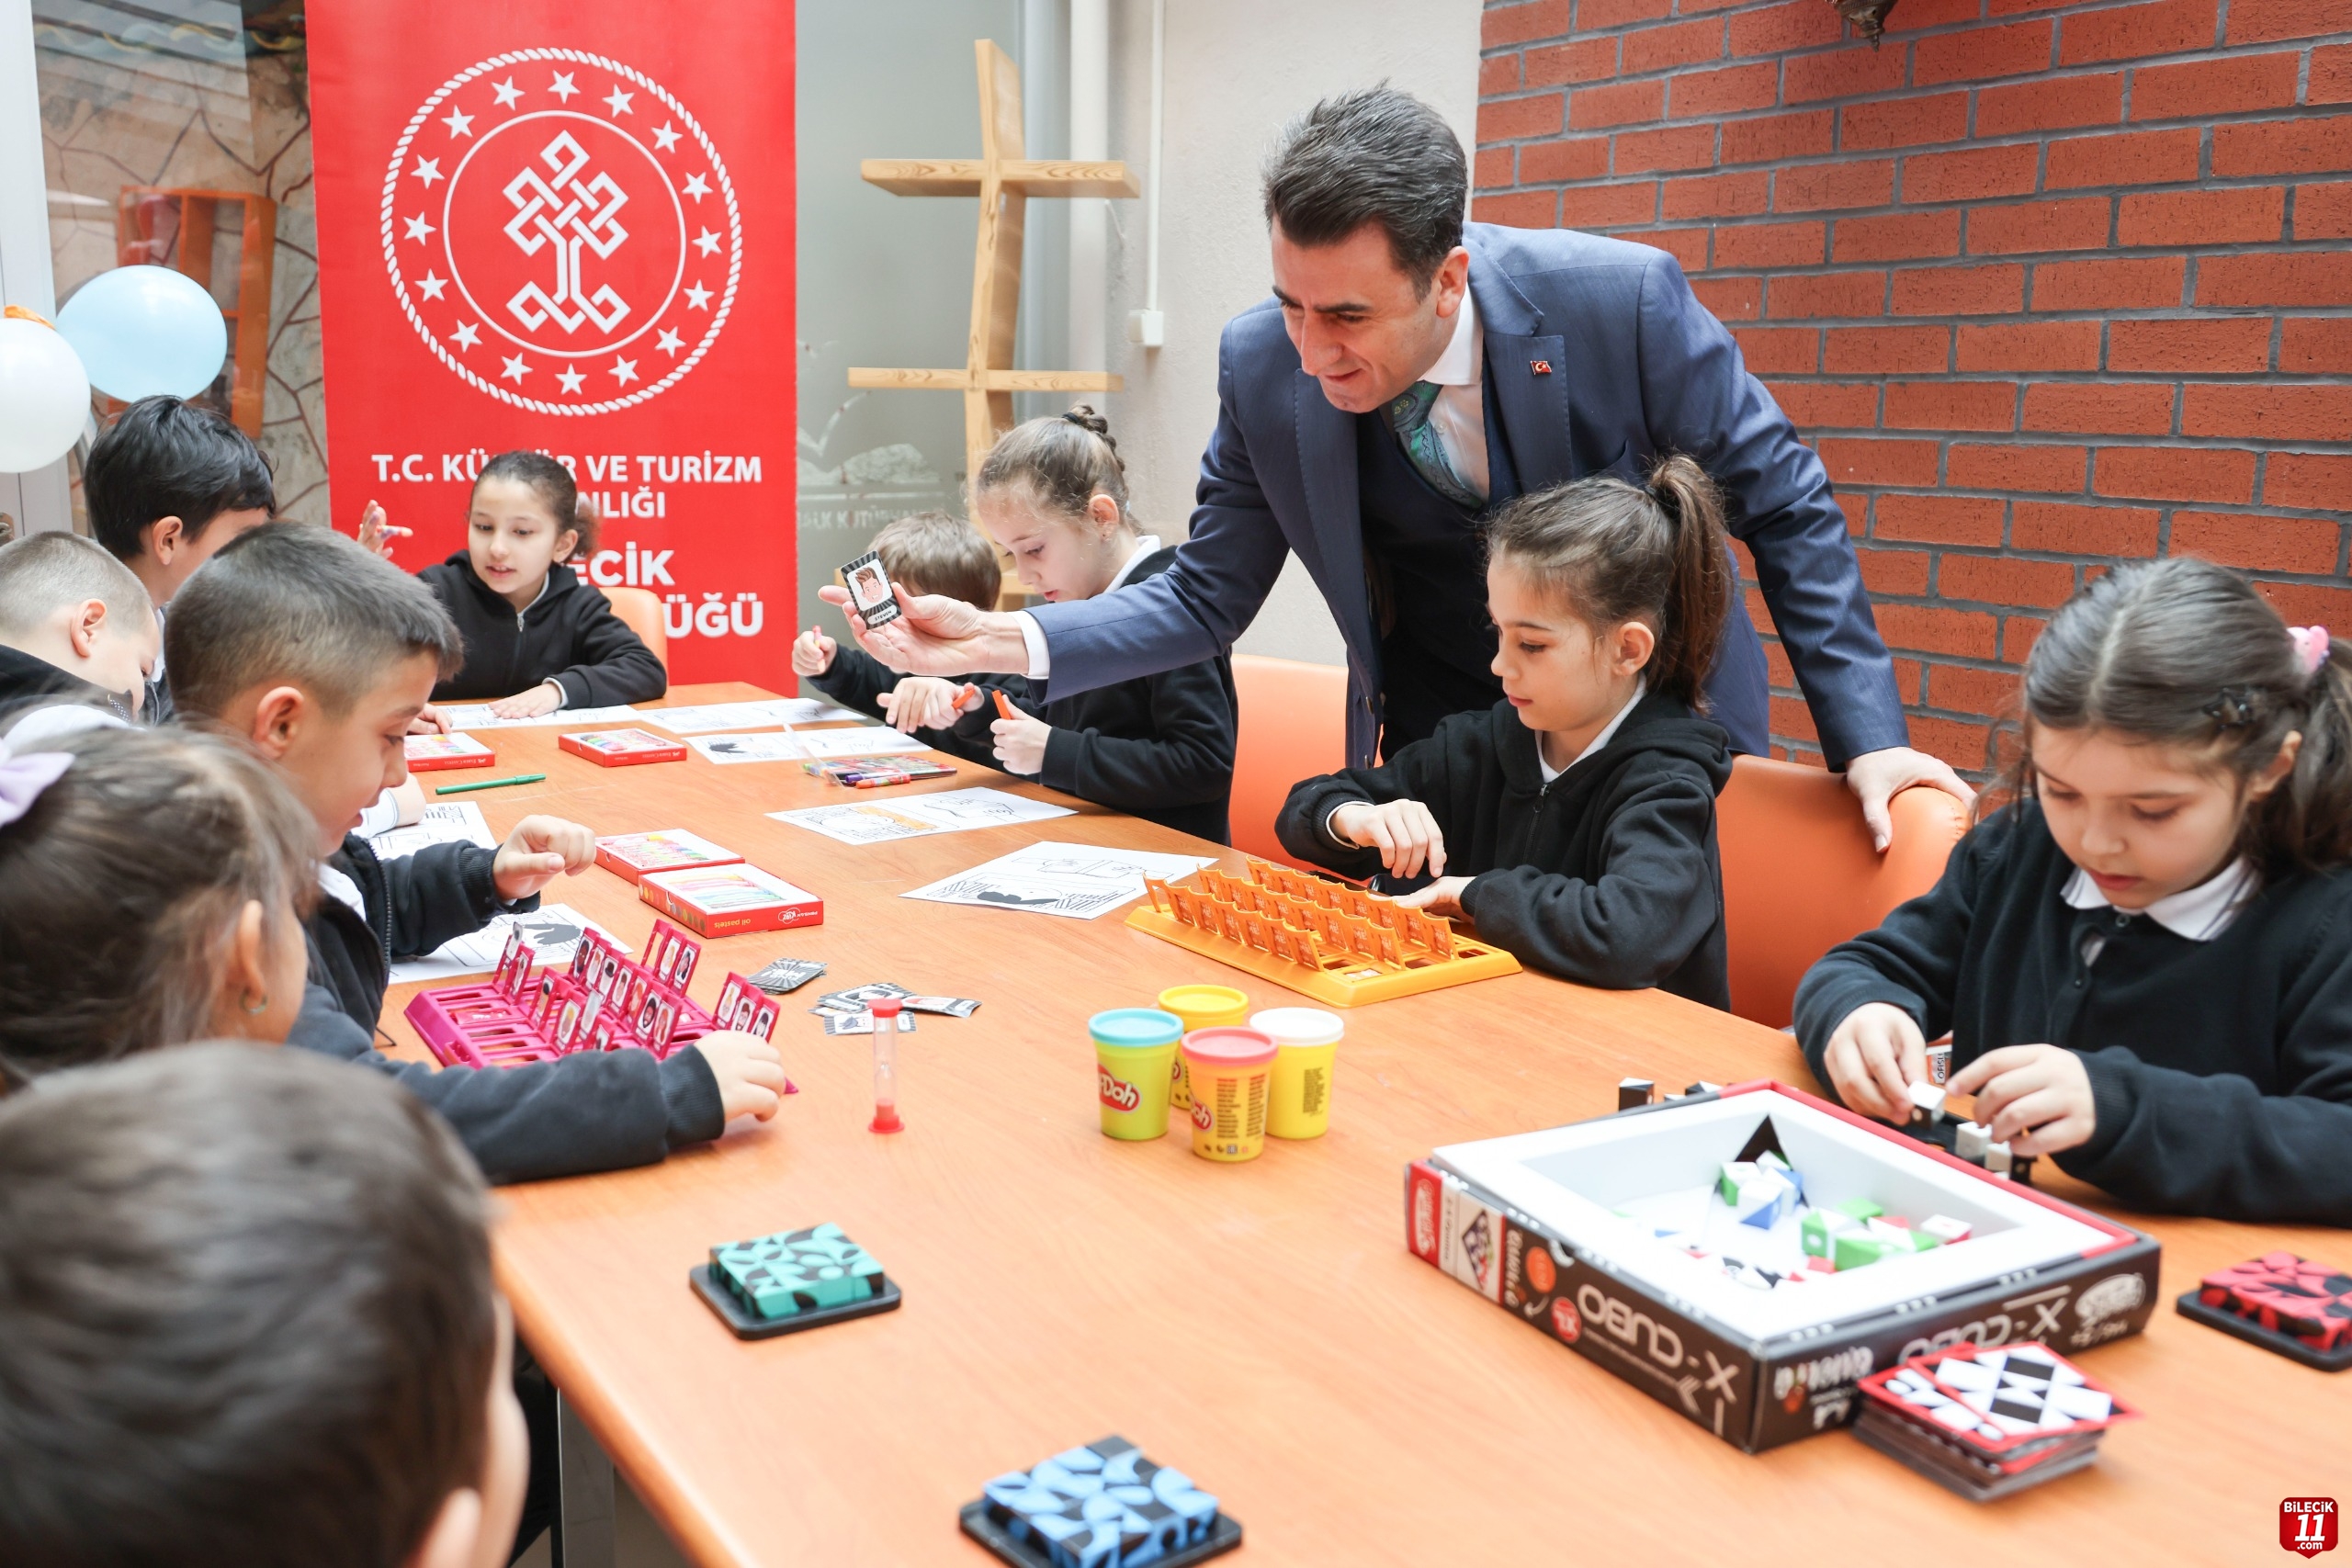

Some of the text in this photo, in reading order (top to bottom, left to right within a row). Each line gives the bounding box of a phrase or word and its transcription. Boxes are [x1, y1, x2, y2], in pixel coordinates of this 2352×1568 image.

[371, 447, 762, 483] T.C. KÜR VE TURİZM
[574, 485, 665, 518] NLIĞI
[566, 541, 675, 586] ECİK
[662, 592, 763, 639] ÜĞÜ
[714, 919, 741, 929] pastels
